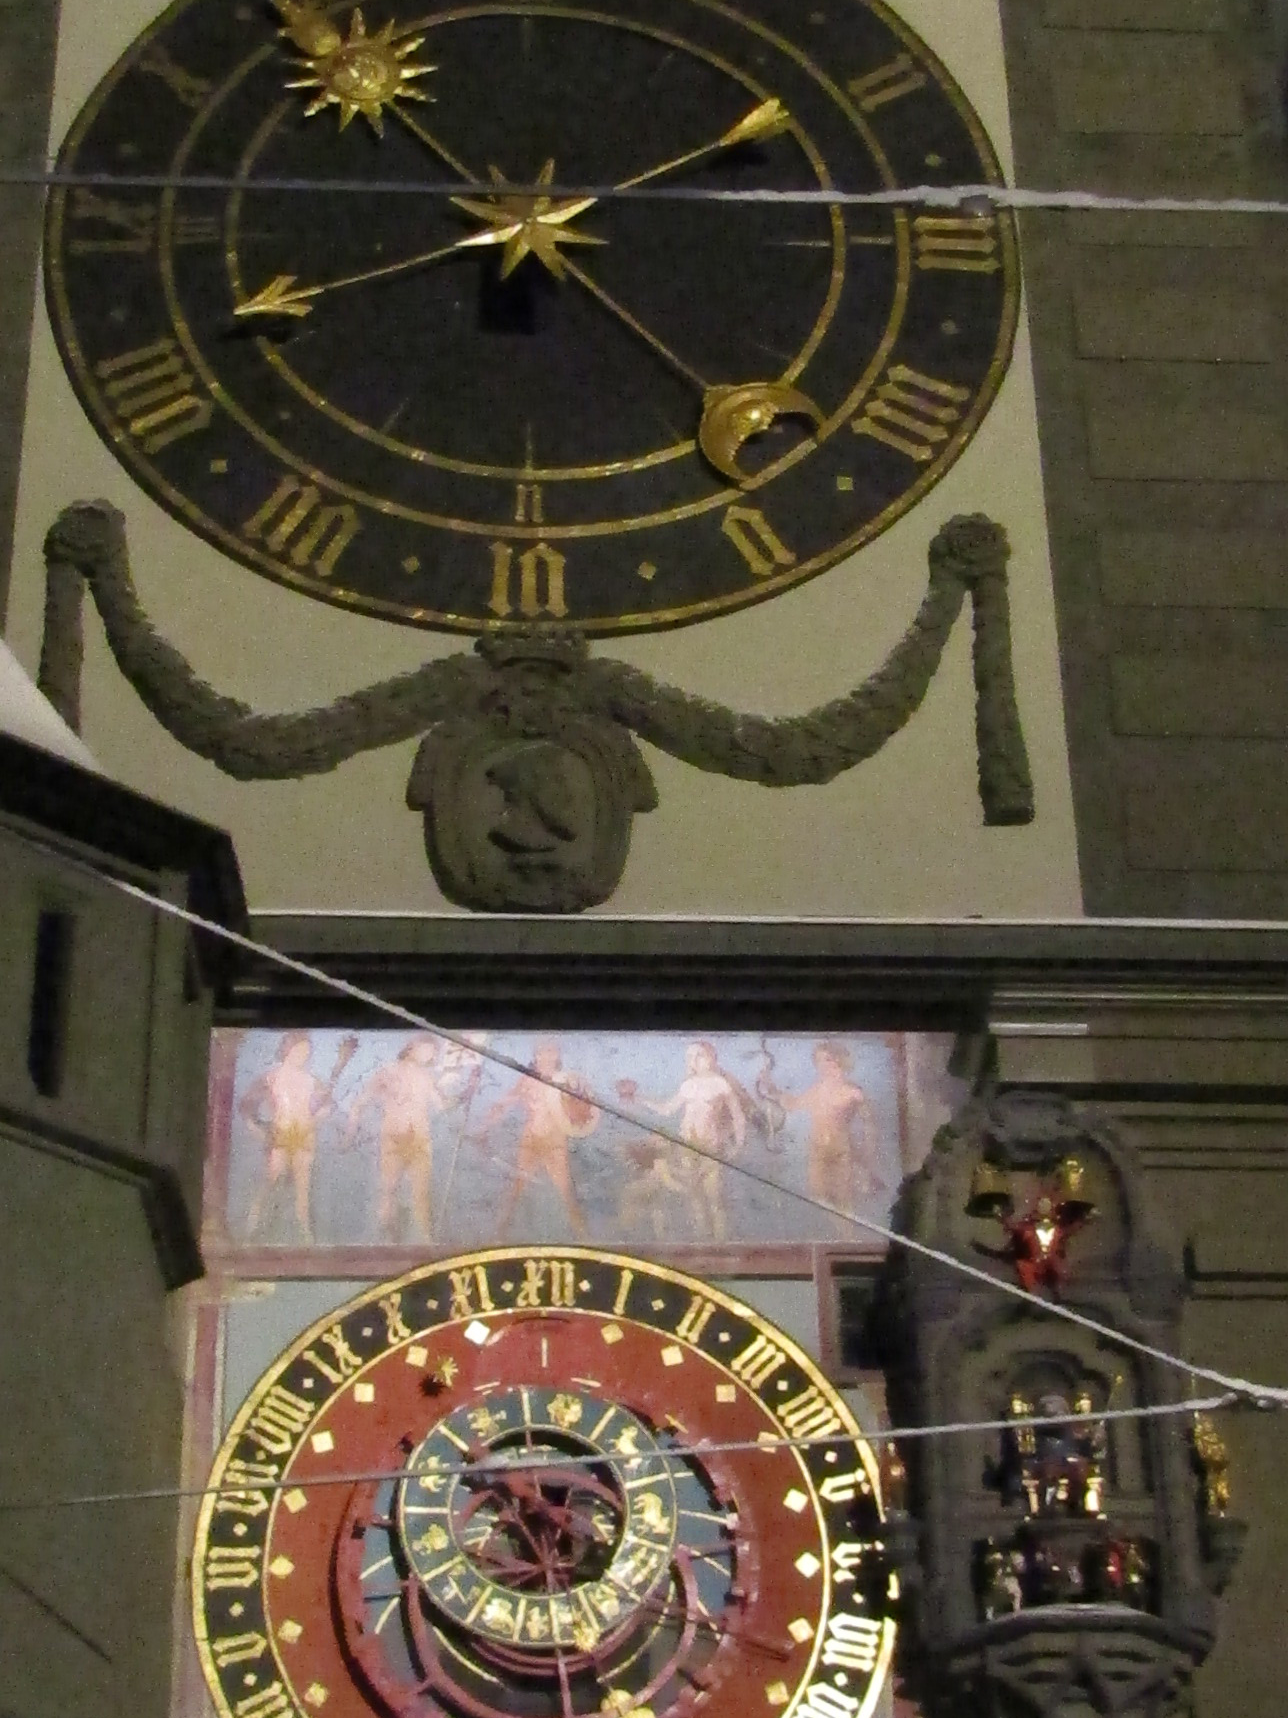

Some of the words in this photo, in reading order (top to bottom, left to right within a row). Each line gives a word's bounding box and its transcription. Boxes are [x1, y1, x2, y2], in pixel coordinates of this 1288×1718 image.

[847, 52, 929, 113] II
[914, 215, 1001, 275] III
[852, 364, 971, 462] IIII
[449, 1264, 495, 1321] XI
[516, 1258, 576, 1307] XII
[612, 1268, 634, 1316] I
[379, 1292, 412, 1345] X
[675, 1294, 717, 1344] II
[302, 1324, 363, 1384] IX
[730, 1334, 787, 1390] III
[248, 1384, 315, 1456] VIII
[206, 1544, 262, 1592] VI
[820, 1611, 883, 1673] VII
